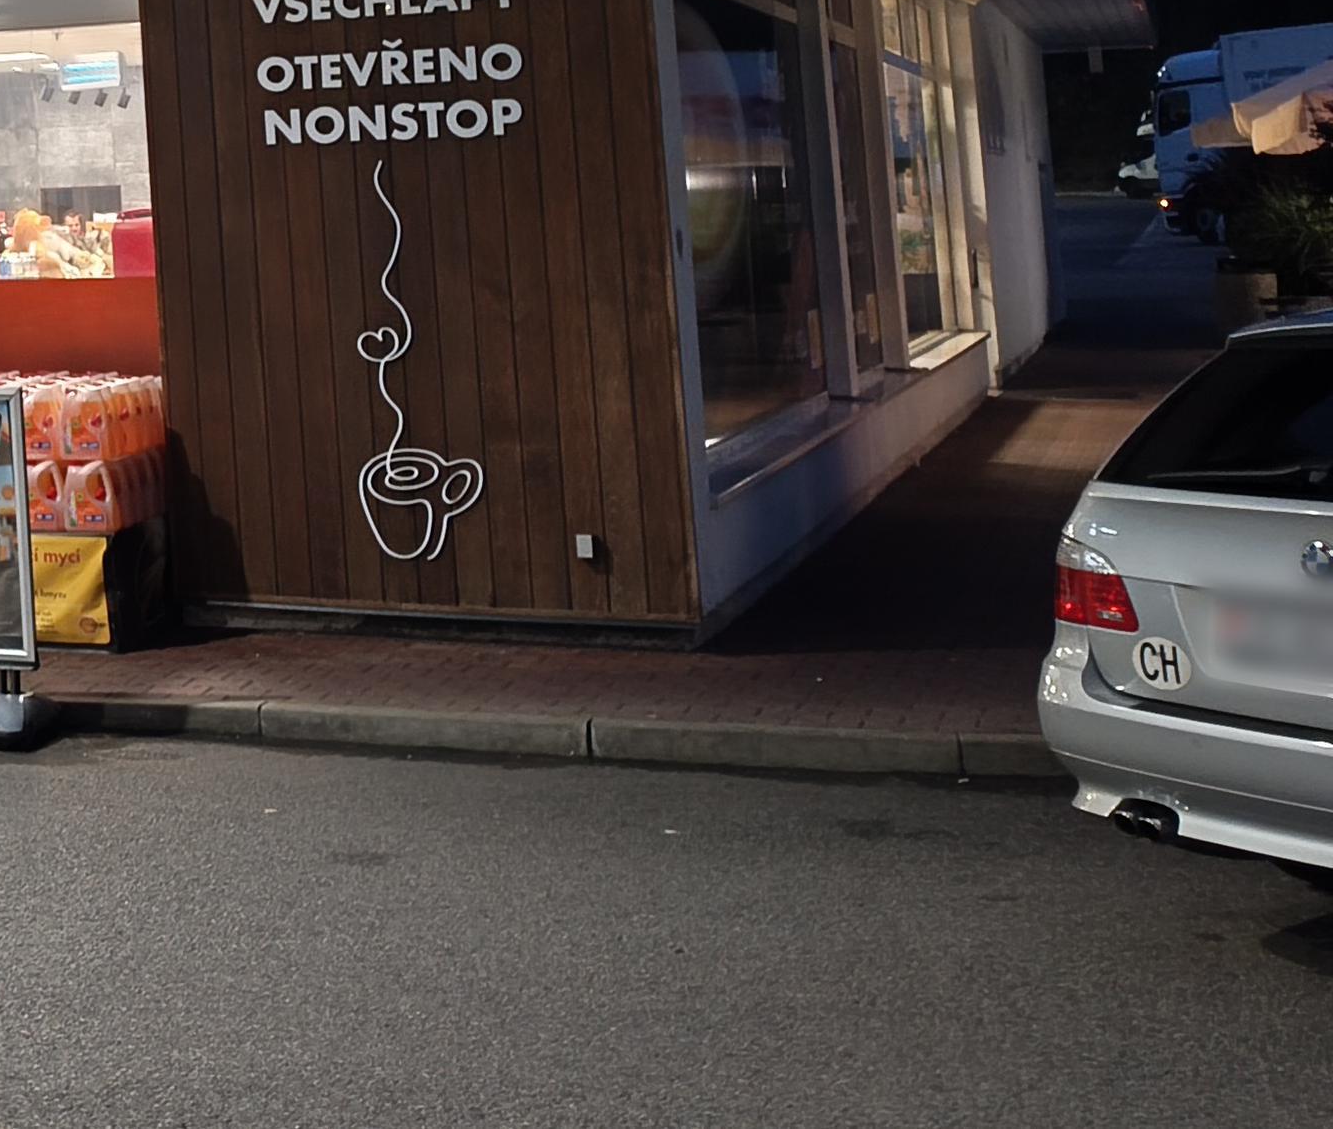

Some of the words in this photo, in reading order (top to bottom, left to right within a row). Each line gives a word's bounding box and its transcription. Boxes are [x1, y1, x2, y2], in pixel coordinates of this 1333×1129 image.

[256, 38, 522, 92] OTEVŘENO
[263, 99, 523, 146] NONSTOP
[43, 548, 81, 567] mycí
[1140, 642, 1182, 685] CH
